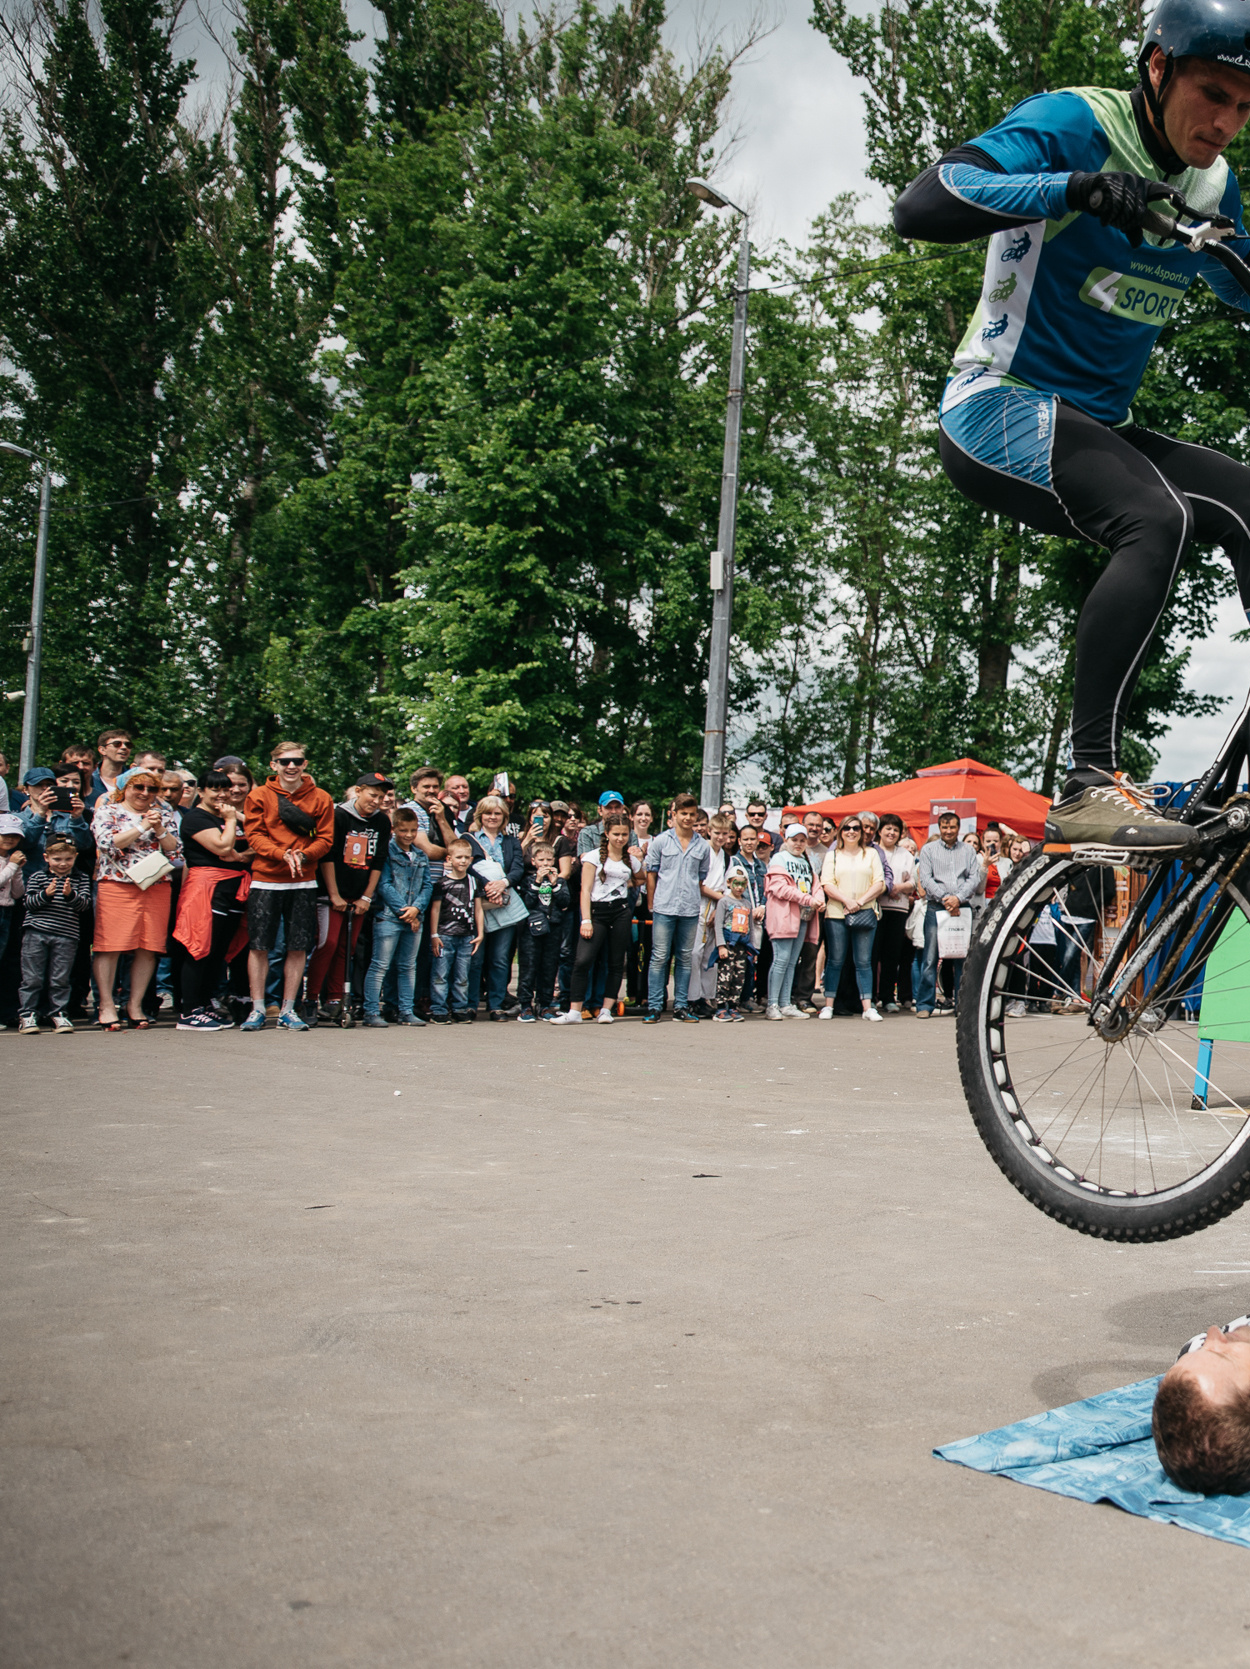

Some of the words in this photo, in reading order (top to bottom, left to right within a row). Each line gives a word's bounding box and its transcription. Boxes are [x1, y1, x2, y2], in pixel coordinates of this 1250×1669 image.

[1130, 261, 1190, 285] www.4sport.ru
[1120, 287, 1178, 319] SPORT
[353, 843, 361, 855] 9
